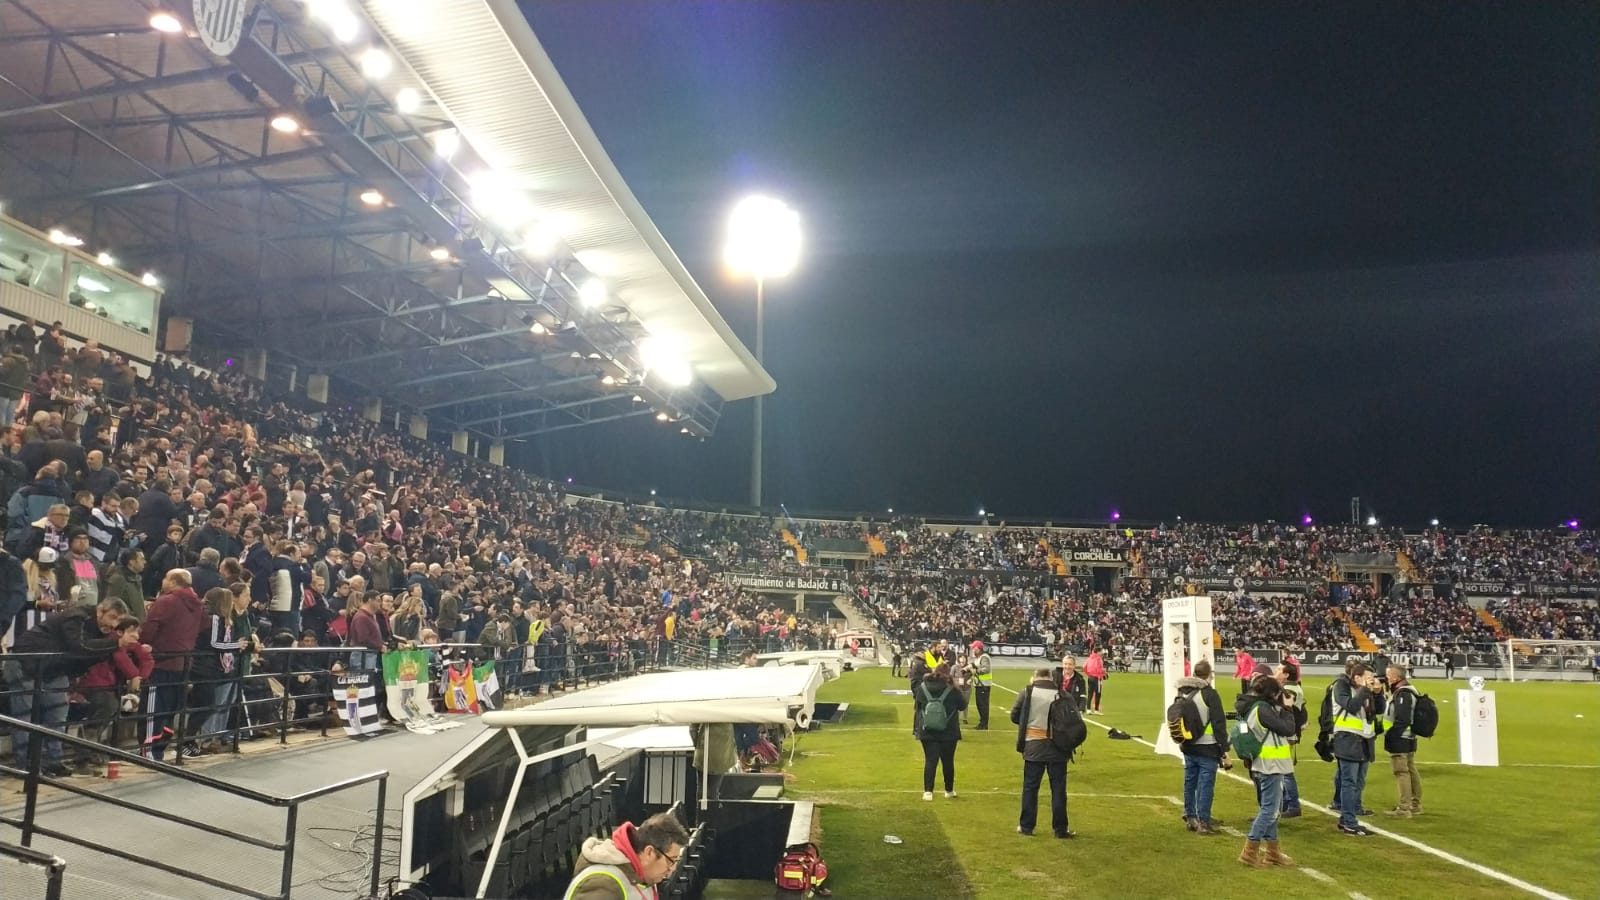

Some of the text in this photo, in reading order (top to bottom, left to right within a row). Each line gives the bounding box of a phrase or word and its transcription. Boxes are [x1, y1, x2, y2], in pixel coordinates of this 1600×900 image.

[1074, 551, 1122, 561] CORCHUELA
[732, 575, 829, 590] Ayuntamiento de Badajoz
[1480, 585, 1504, 593] ESTOY
